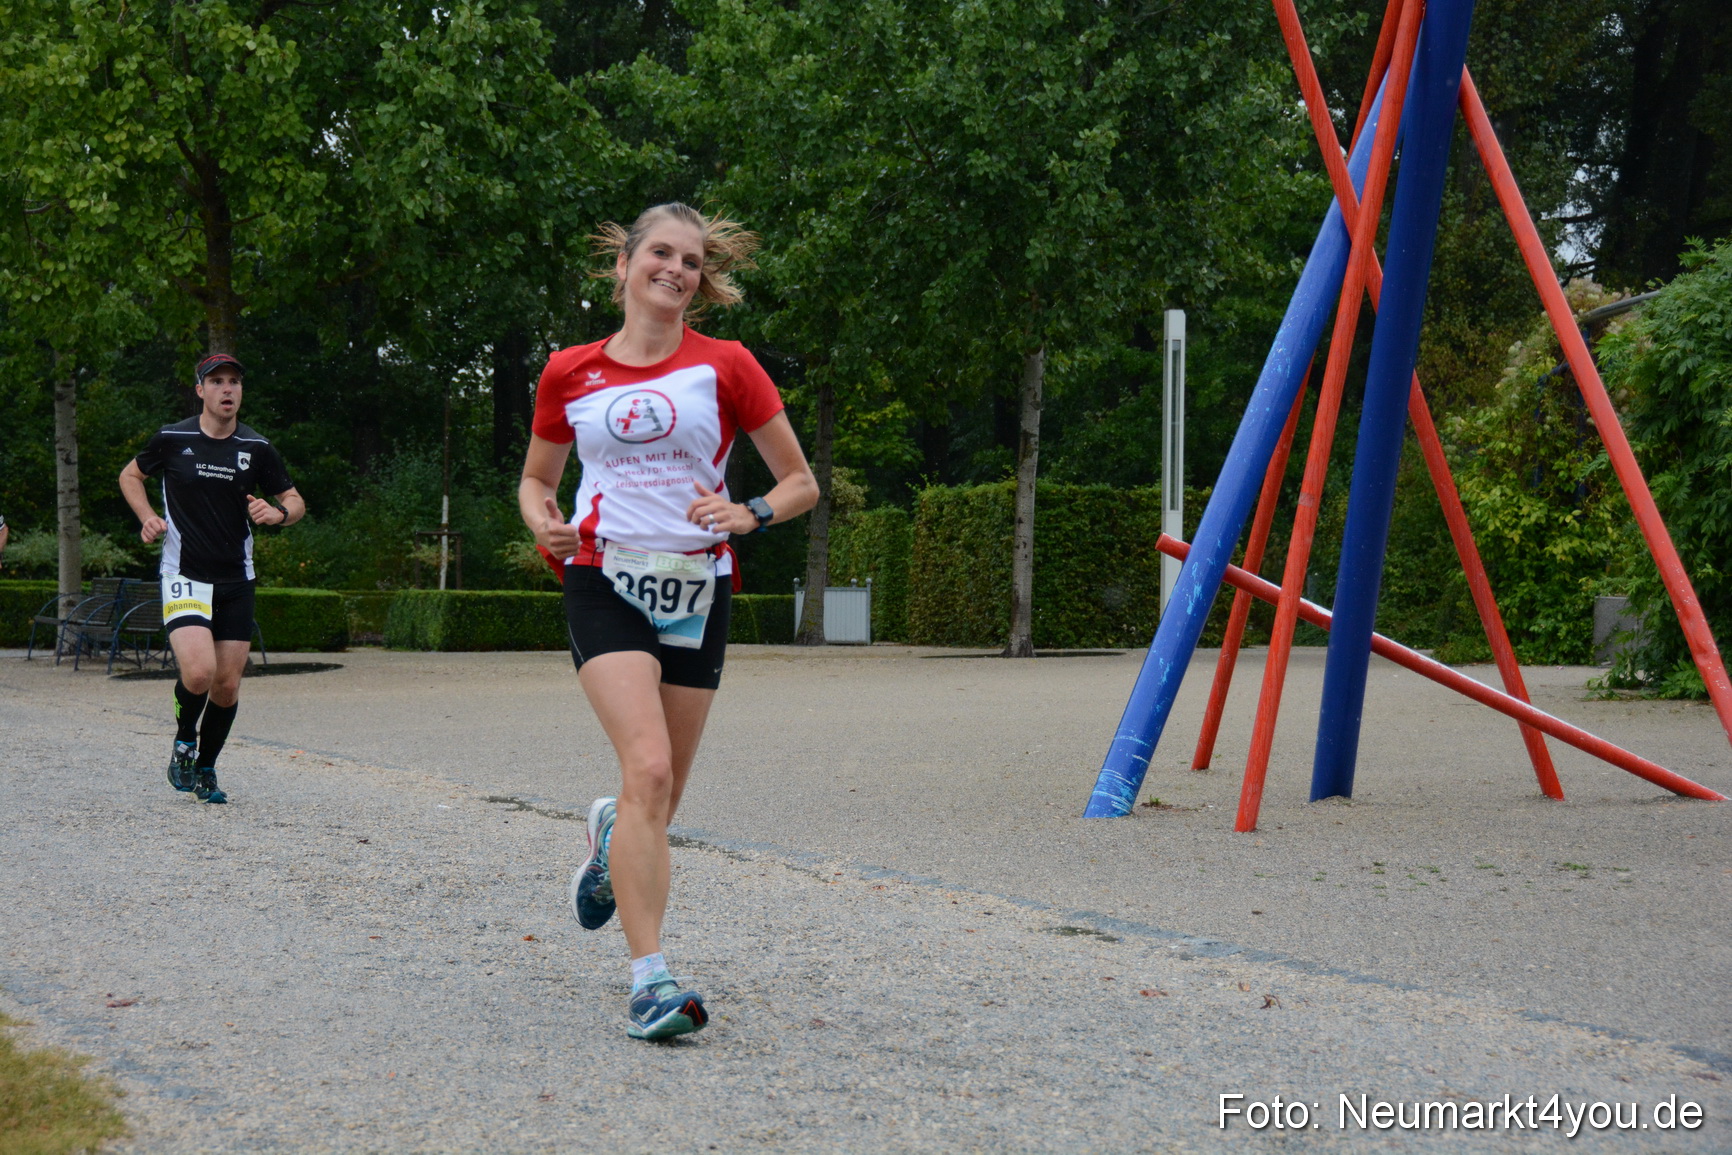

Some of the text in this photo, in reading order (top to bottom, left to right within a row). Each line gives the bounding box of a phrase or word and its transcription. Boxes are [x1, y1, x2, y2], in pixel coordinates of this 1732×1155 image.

[585, 378, 606, 386] erima
[605, 456, 641, 469] AUFEN
[645, 452, 667, 463] MIT
[207, 464, 236, 474] Marathon
[198, 470, 234, 481] Regensburg
[171, 581, 193, 599] 91
